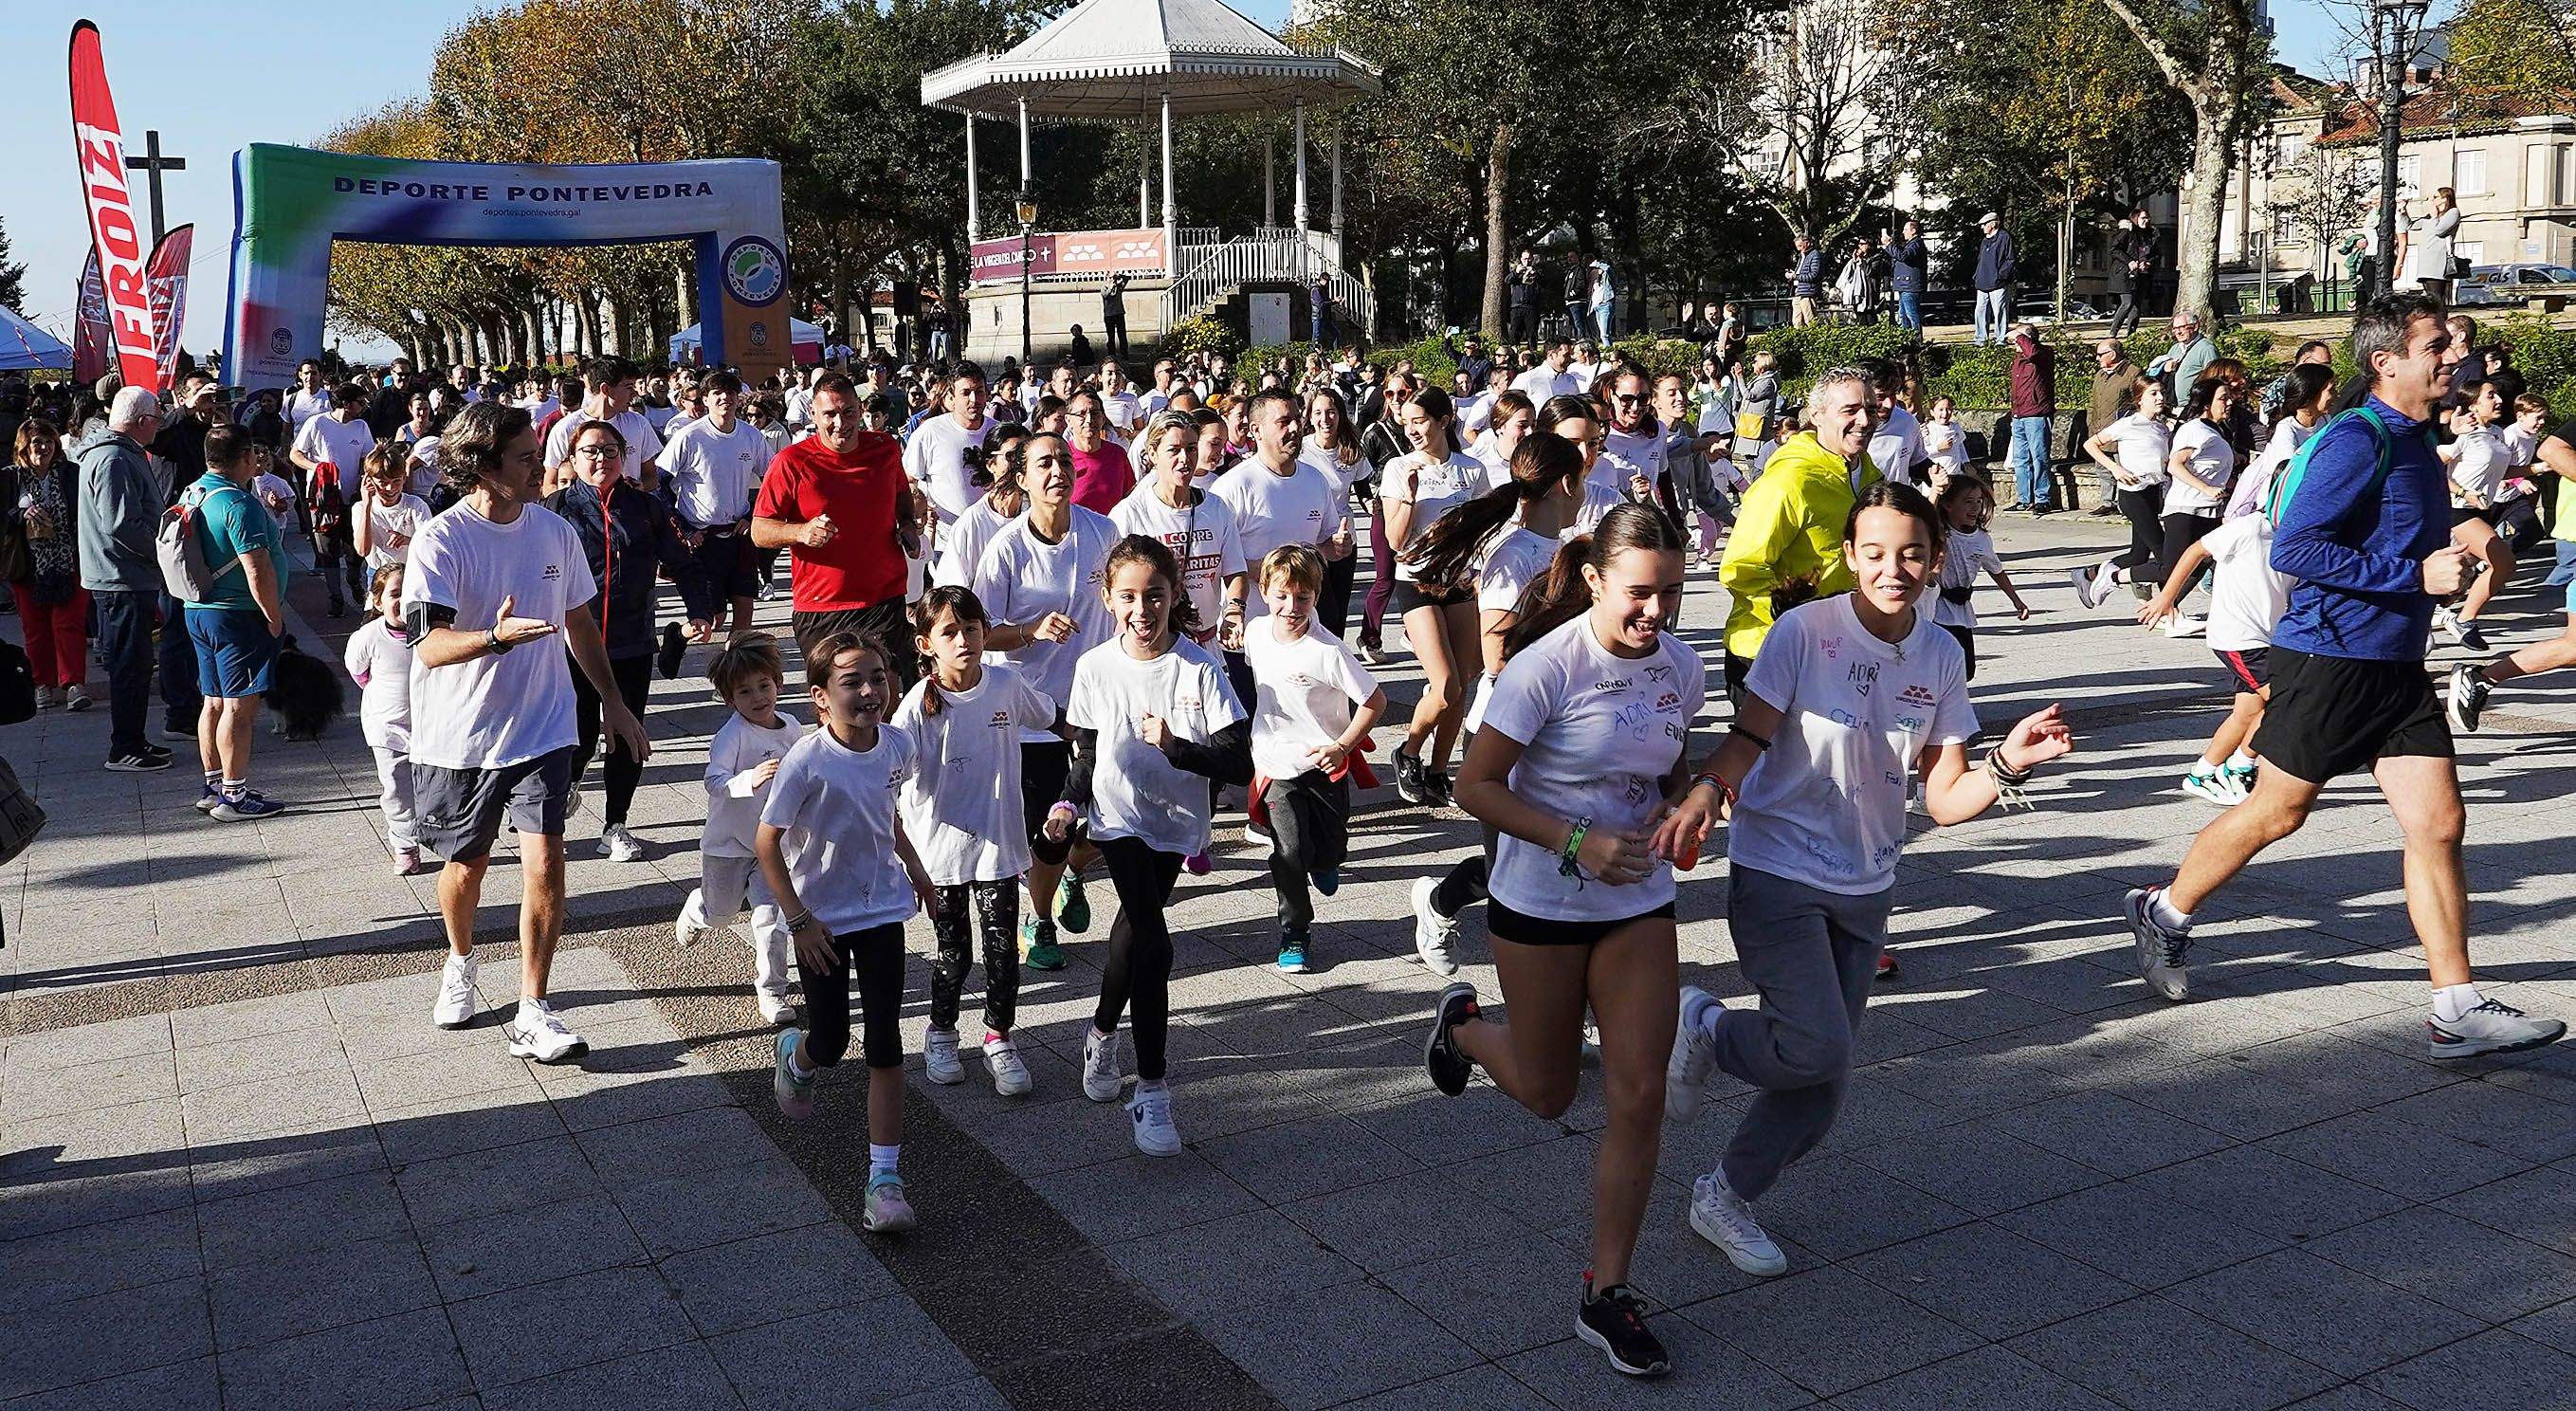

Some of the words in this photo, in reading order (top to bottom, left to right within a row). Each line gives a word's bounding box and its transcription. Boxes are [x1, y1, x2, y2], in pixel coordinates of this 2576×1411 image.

[334, 177, 489, 201] DEPORTE
[507, 181, 714, 202] PONTEVEDRA
[482, 208, 581, 218] deportes.pontevedra.gal
[82, 137, 153, 349] FROIZ
[731, 245, 776, 262] DEPORTE
[729, 274, 780, 299] PONTEVEDRA
[2489, 272, 2510, 284] GLS
[1182, 557, 1220, 570] ARITAS
